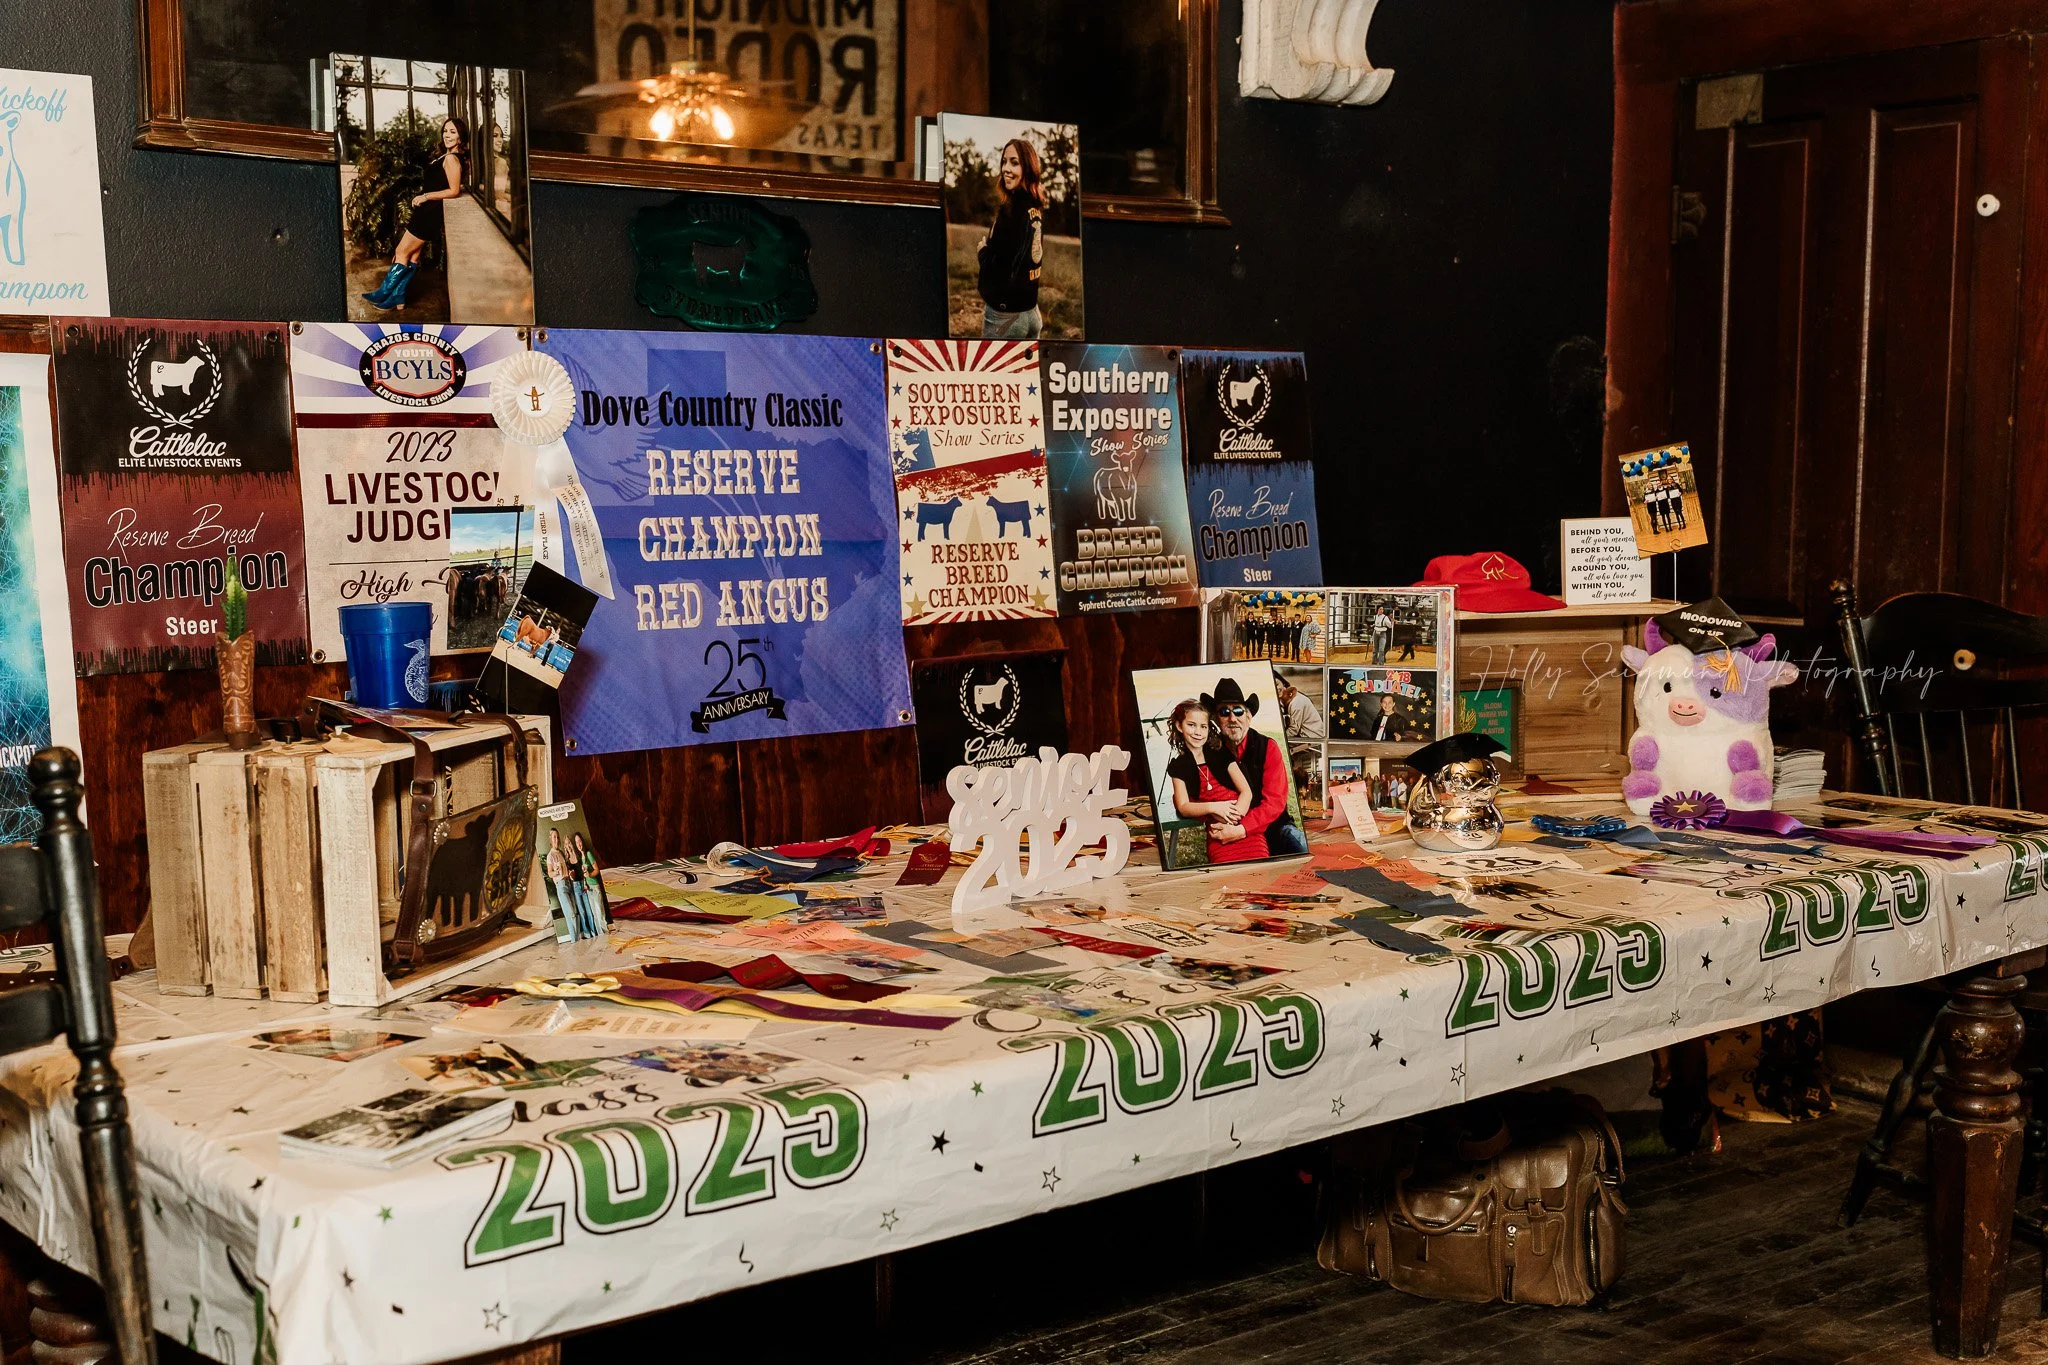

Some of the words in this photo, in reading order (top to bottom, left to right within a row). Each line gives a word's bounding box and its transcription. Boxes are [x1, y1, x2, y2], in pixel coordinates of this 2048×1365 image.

[0, 86, 67, 122] ickoff
[366, 332, 411, 357] BRAZOS
[413, 332, 458, 357] COUNTY
[394, 348, 434, 358] YOUTH
[375, 359, 453, 381] BCYLS
[1049, 361, 1170, 396] Southern
[375, 385, 429, 407] LIVESTOCK
[430, 386, 455, 405] SHOW
[907, 383, 1022, 404] SOUTHERN
[582, 389, 650, 428] Dove
[659, 389, 758, 433] Country
[765, 392, 844, 428] Classic
[908, 405, 1023, 427] EXPOSURE
[1052, 400, 1173, 441] Exposure
[129, 425, 227, 459] Cattlelac
[386, 429, 453, 464] 2023
[933, 429, 972, 448] Show
[980, 430, 1025, 446] Series
[1090, 438, 1125, 458] Show
[1131, 431, 1169, 451] Series
[1219, 428, 1274, 453] Cattlelac
[118, 458, 147, 468] ELITE
[148, 457, 201, 468] LIVESTOCK
[204, 457, 242, 468] EVENTS
[1214, 452, 1229, 460] ELITE
[1229, 451, 1260, 460] LIVESTOCK
[1260, 451, 1282, 459] EVENTS
[646, 448, 801, 496] RESERVE
[1208, 488, 1242, 526] Reserve
[1246, 485, 1294, 520] Breed
[107, 509, 170, 563] Reserve
[177, 502, 264, 550] Breed
[638, 513, 823, 563] CHAMPION
[1075, 525, 1164, 560] BREED
[1200, 516, 1309, 563] Champion
[1570, 528, 1601, 536] BEHIND
[1604, 528, 1624, 536] YOU,
[1581, 536, 1592, 544] all
[1593, 536, 1609, 546] your
[931, 542, 1020, 564] RESERVE
[1570, 546, 1601, 554] BEFORE
[1584, 555, 1595, 563] all
[1596, 556, 1612, 565] your
[945, 565, 1009, 586] BREED
[1059, 554, 1190, 592] CHAMPION
[1243, 567, 1272, 583] Steer
[1571, 564, 1607, 572] AROUND
[1583, 573, 1594, 581] all
[1612, 572, 1628, 580] love
[340, 569, 413, 604] High
[928, 584, 1029, 610] CHAMPION
[1571, 582, 1602, 590] WITHIN
[1604, 581, 1625, 589] YOU,
[1591, 591, 1603, 599] all
[1604, 591, 1617, 600] you
[634, 584, 703, 632] RED
[715, 577, 829, 627] ANGUS
[1079, 601, 1106, 612] Syphrett
[1106, 599, 1126, 608] Creek
[1126, 597, 1146, 606] Cattle
[1147, 595, 1177, 606] Company
[166, 614, 218, 638] Steer
[1680, 611, 1743, 628] MOOOVING
[1688, 627, 1706, 636] ON
[1345, 679, 1421, 699] GRADUATE!
[702, 690, 771, 721] ANNIVERSARY
[0, 744, 37, 769] CKPOT
[964, 736, 1027, 764] Cattlelac
[950, 811, 1131, 915] 2025
[1716, 857, 1932, 962] 2025
[1407, 912, 1666, 1040] 2025
[998, 983, 1327, 1138] 2025
[434, 1077, 869, 1269] 2025
